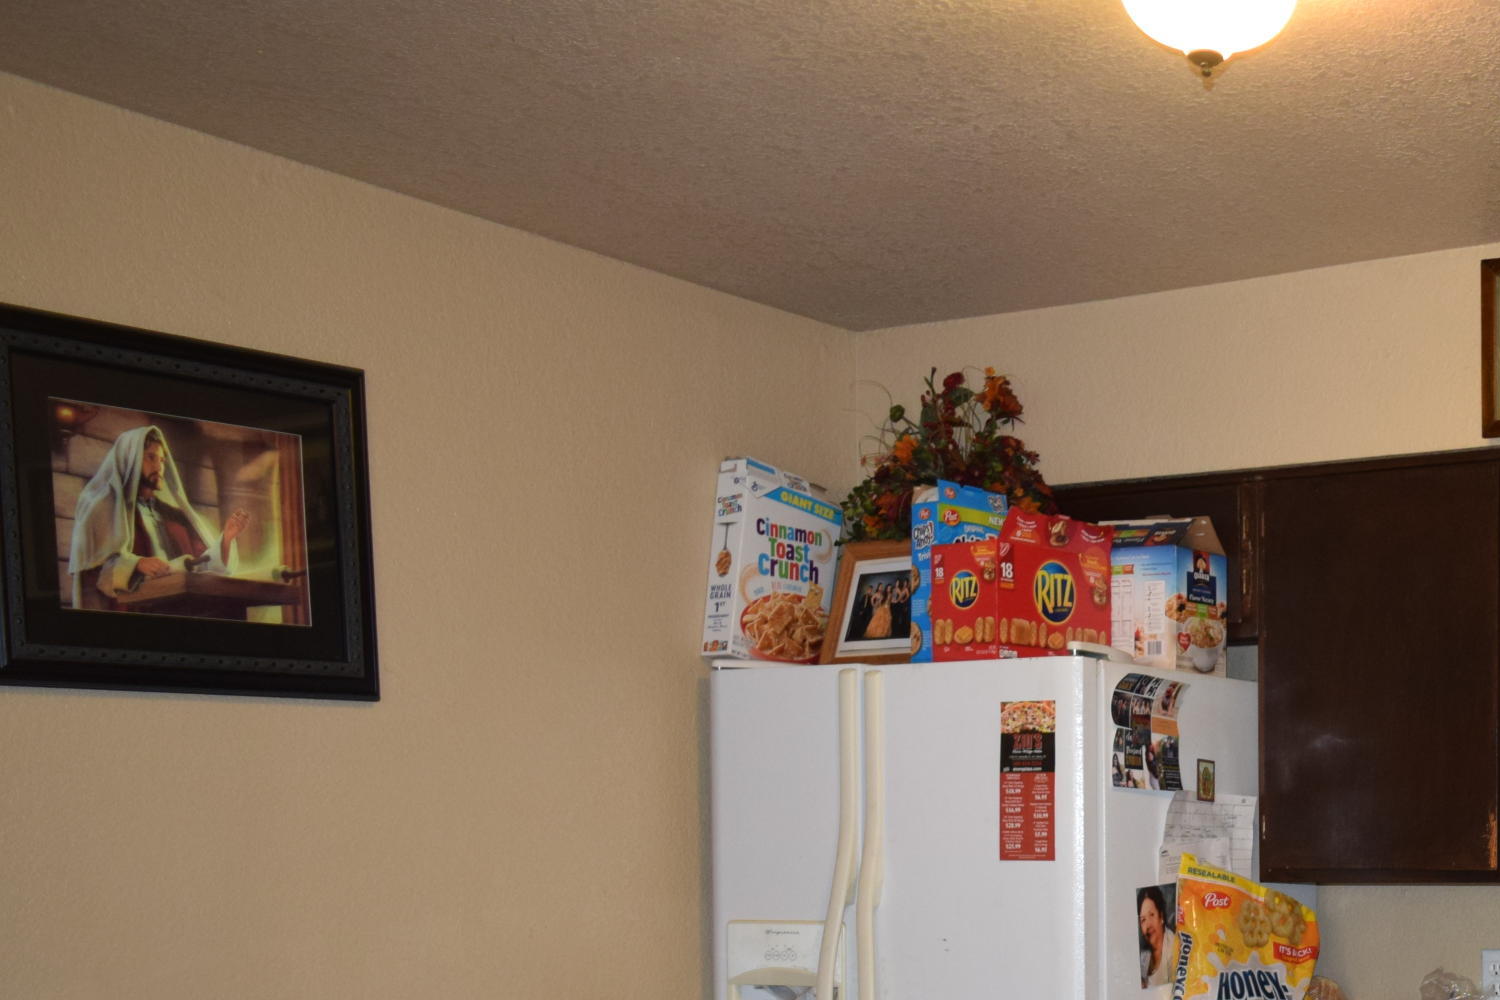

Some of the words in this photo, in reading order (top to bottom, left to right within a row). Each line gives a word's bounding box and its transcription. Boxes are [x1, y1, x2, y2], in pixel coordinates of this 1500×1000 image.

[781, 491, 812, 511] GIANT
[813, 503, 835, 520] SIZE
[756, 517, 823, 546] Cinnamon
[768, 538, 811, 562] Toast
[758, 553, 819, 585] Crunch
[935, 567, 945, 578] 18
[1000, 561, 1014, 579] 18
[709, 591, 732, 600] GRAIN
[710, 583, 732, 592] WHOLE
[953, 576, 977, 604] RITZ
[1037, 569, 1073, 615] RITZ
[1187, 867, 1236, 884] RESEALABLE
[1204, 891, 1230, 908] Post
